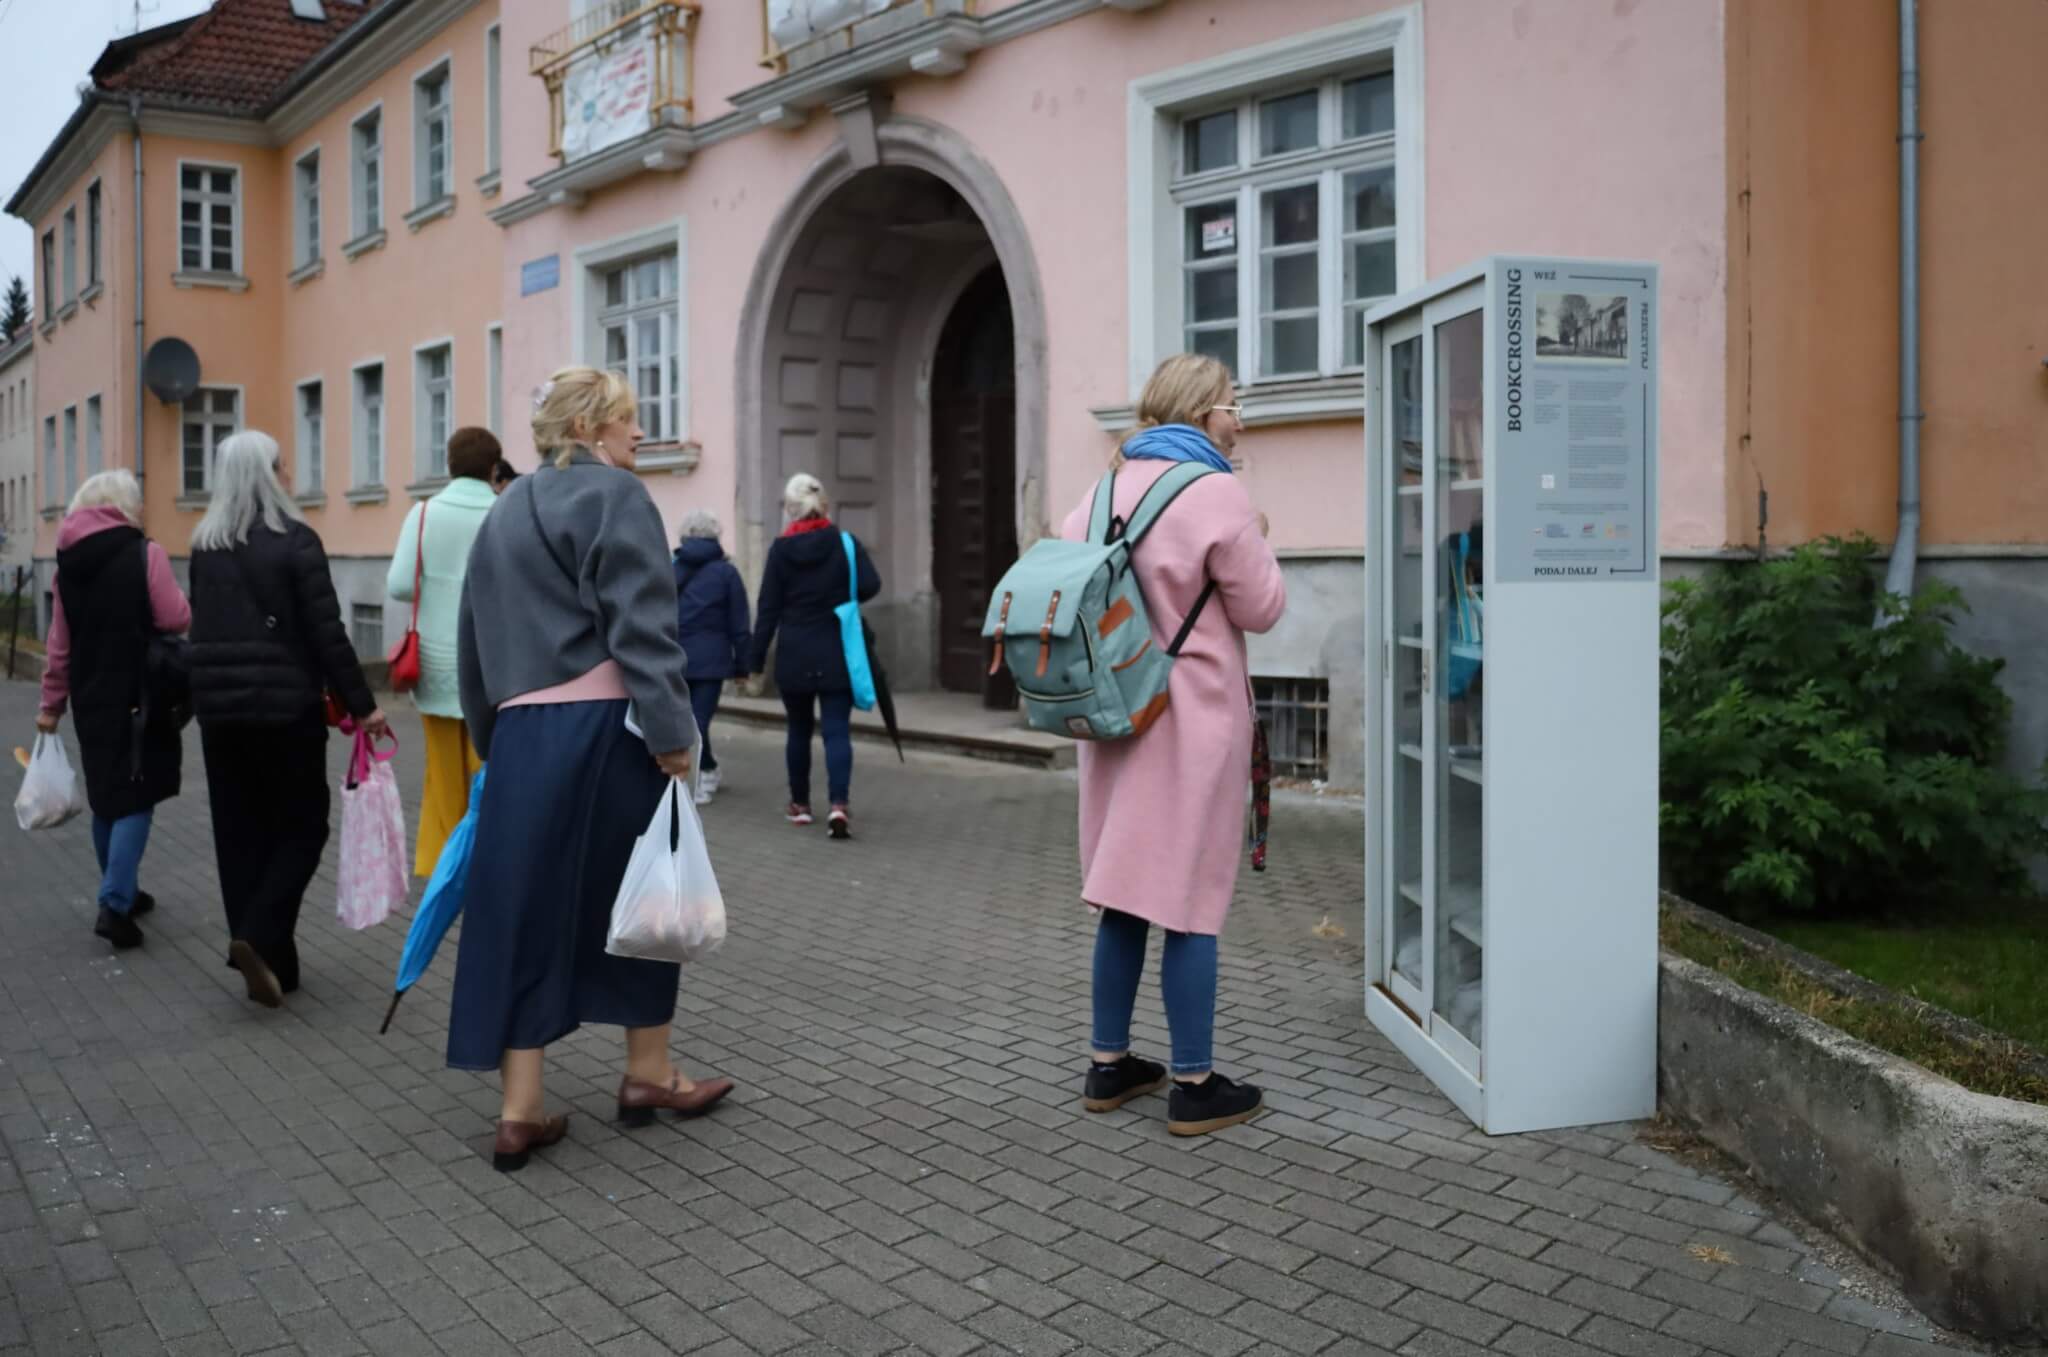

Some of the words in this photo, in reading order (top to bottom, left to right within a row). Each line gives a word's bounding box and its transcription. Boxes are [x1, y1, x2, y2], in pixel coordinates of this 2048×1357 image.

[1507, 268, 1522, 432] BOOKCROSSING
[1534, 567, 1566, 576] PODAJ
[1567, 567, 1599, 576] DALEJ
